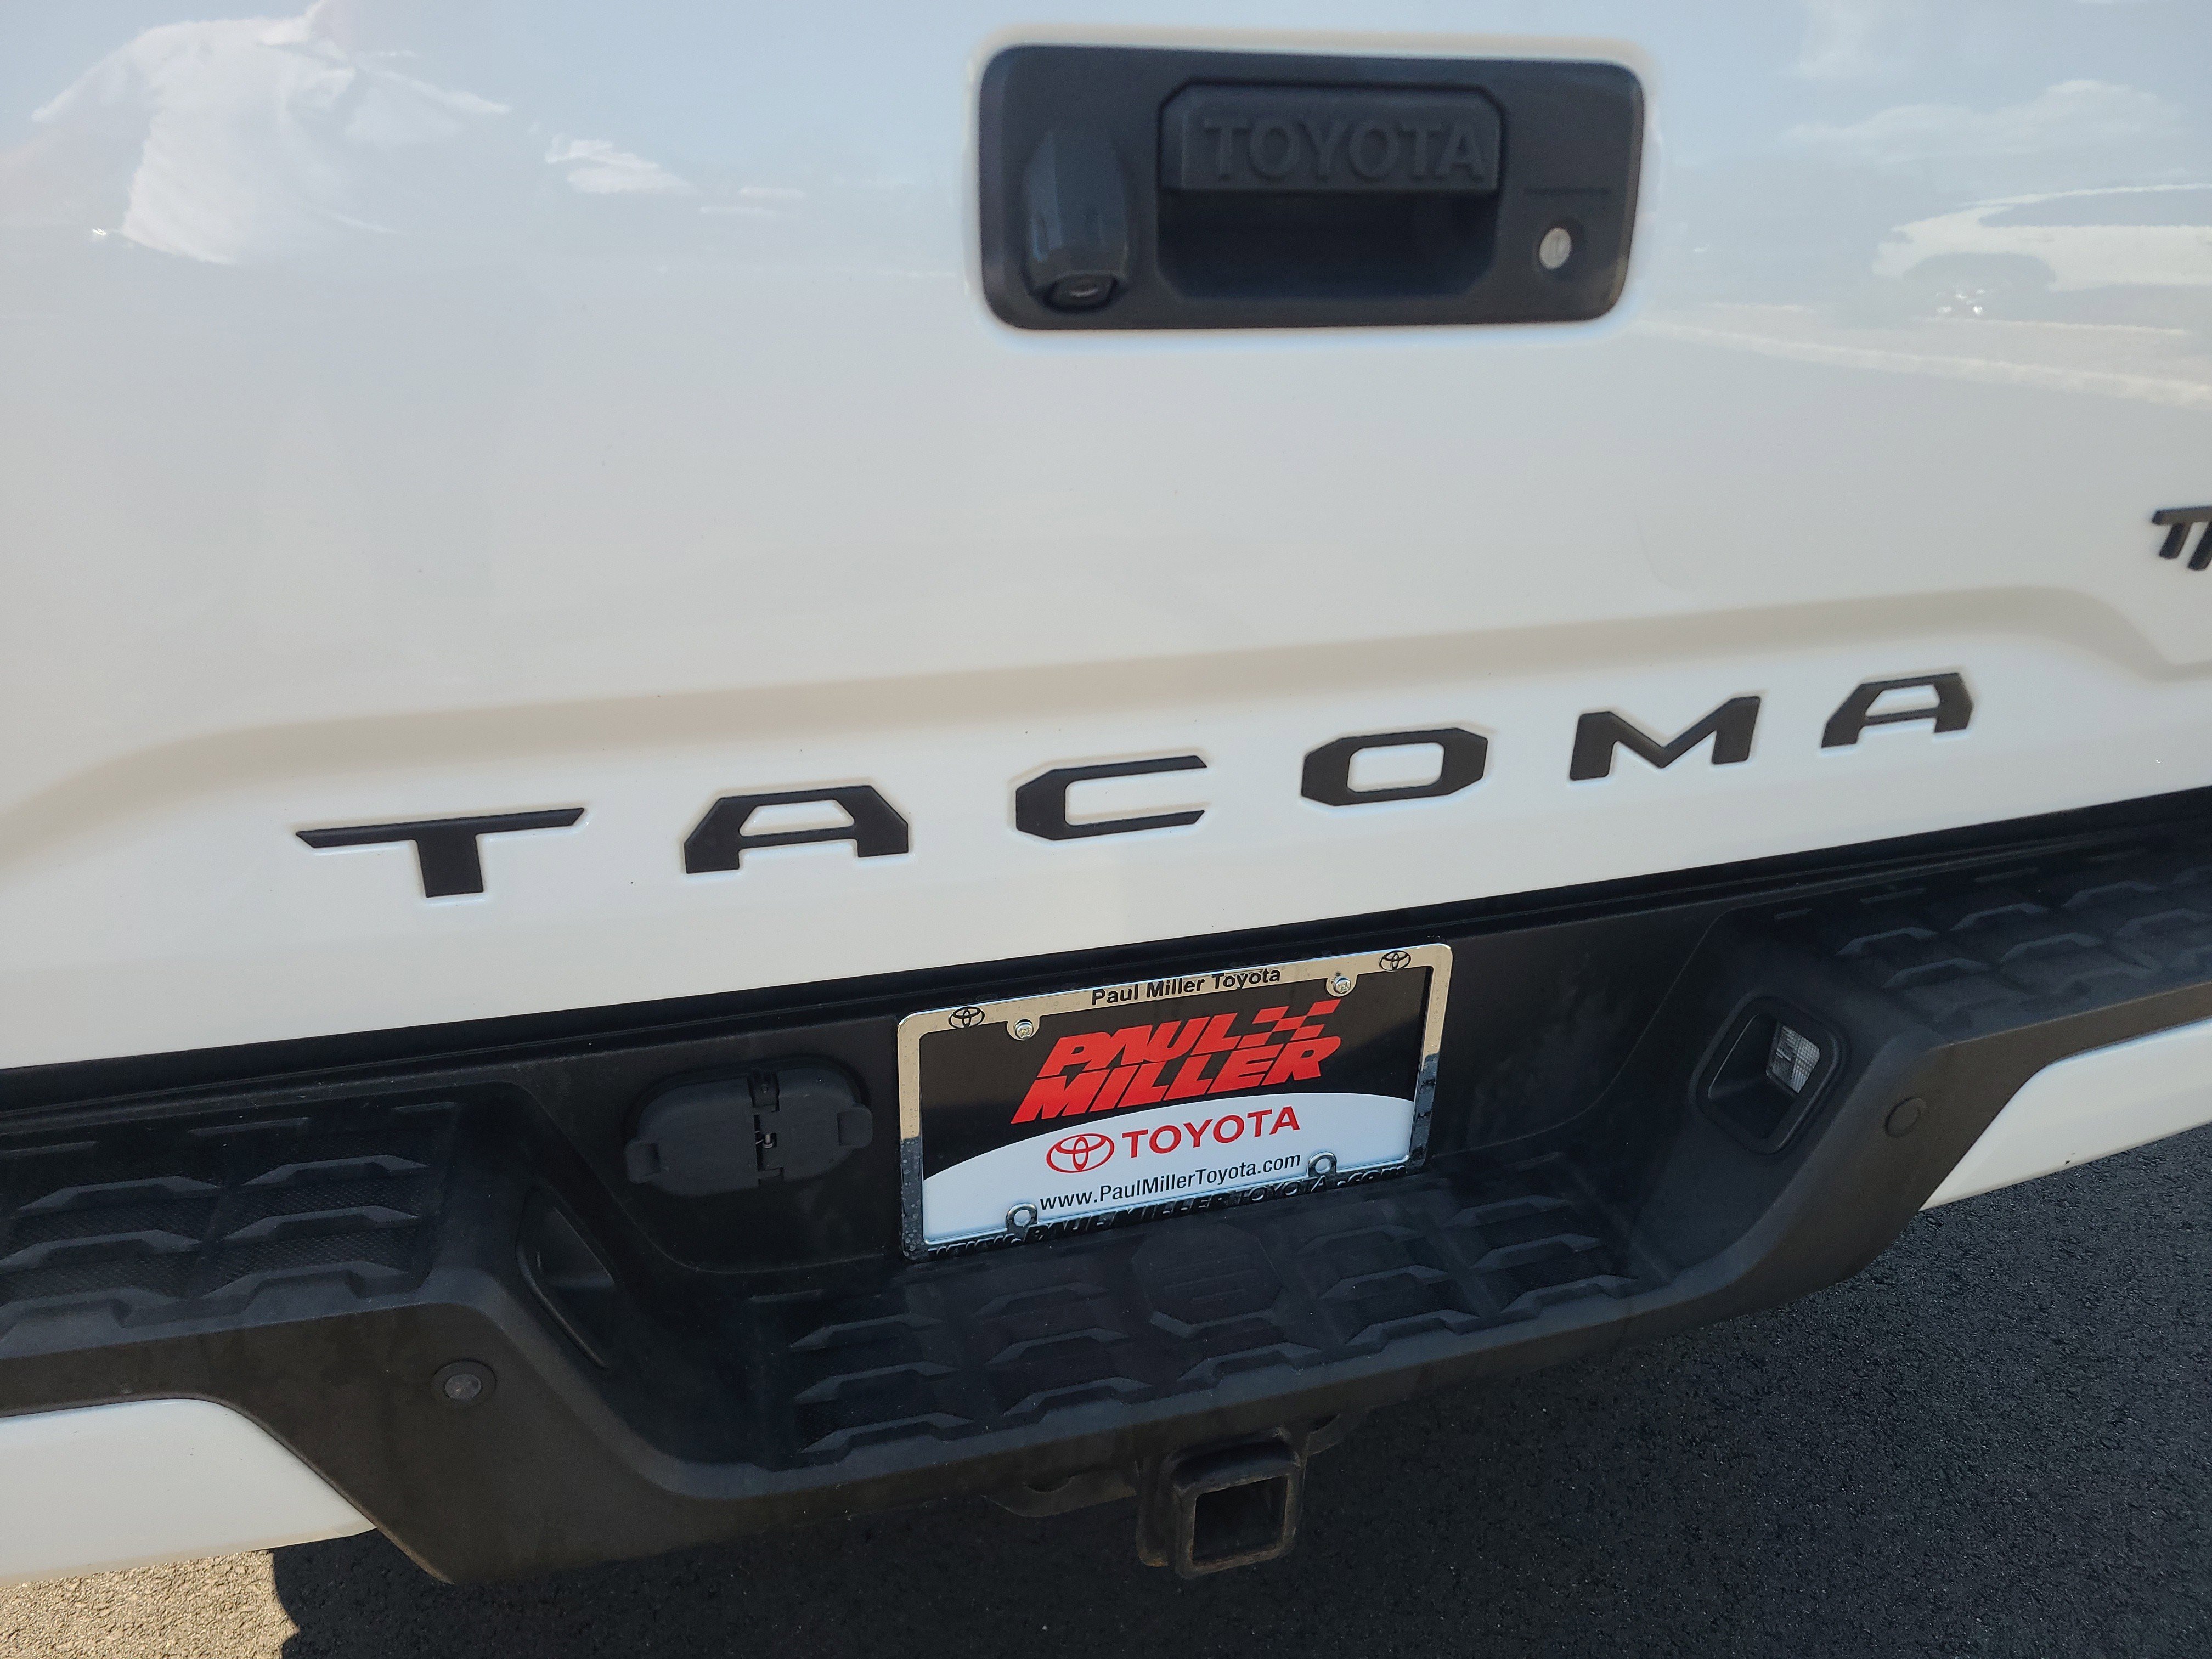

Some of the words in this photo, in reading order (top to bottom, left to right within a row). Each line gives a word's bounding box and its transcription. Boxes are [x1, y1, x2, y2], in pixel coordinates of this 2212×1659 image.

[1205, 116, 1483, 180] TOYOTA
[295, 670, 1976, 899] TACOMA
[1091, 984, 1139, 1006] Paul
[1146, 978, 1205, 998] Miller
[1211, 967, 1281, 990] Toyota
[1037, 1012, 1245, 1078] PAUL
[1011, 1036, 1342, 1124] MILLER
[1122, 1106, 1300, 1158] TOYOTA
[1040, 1154, 1301, 1210] www.PaulMillerToyota.com
